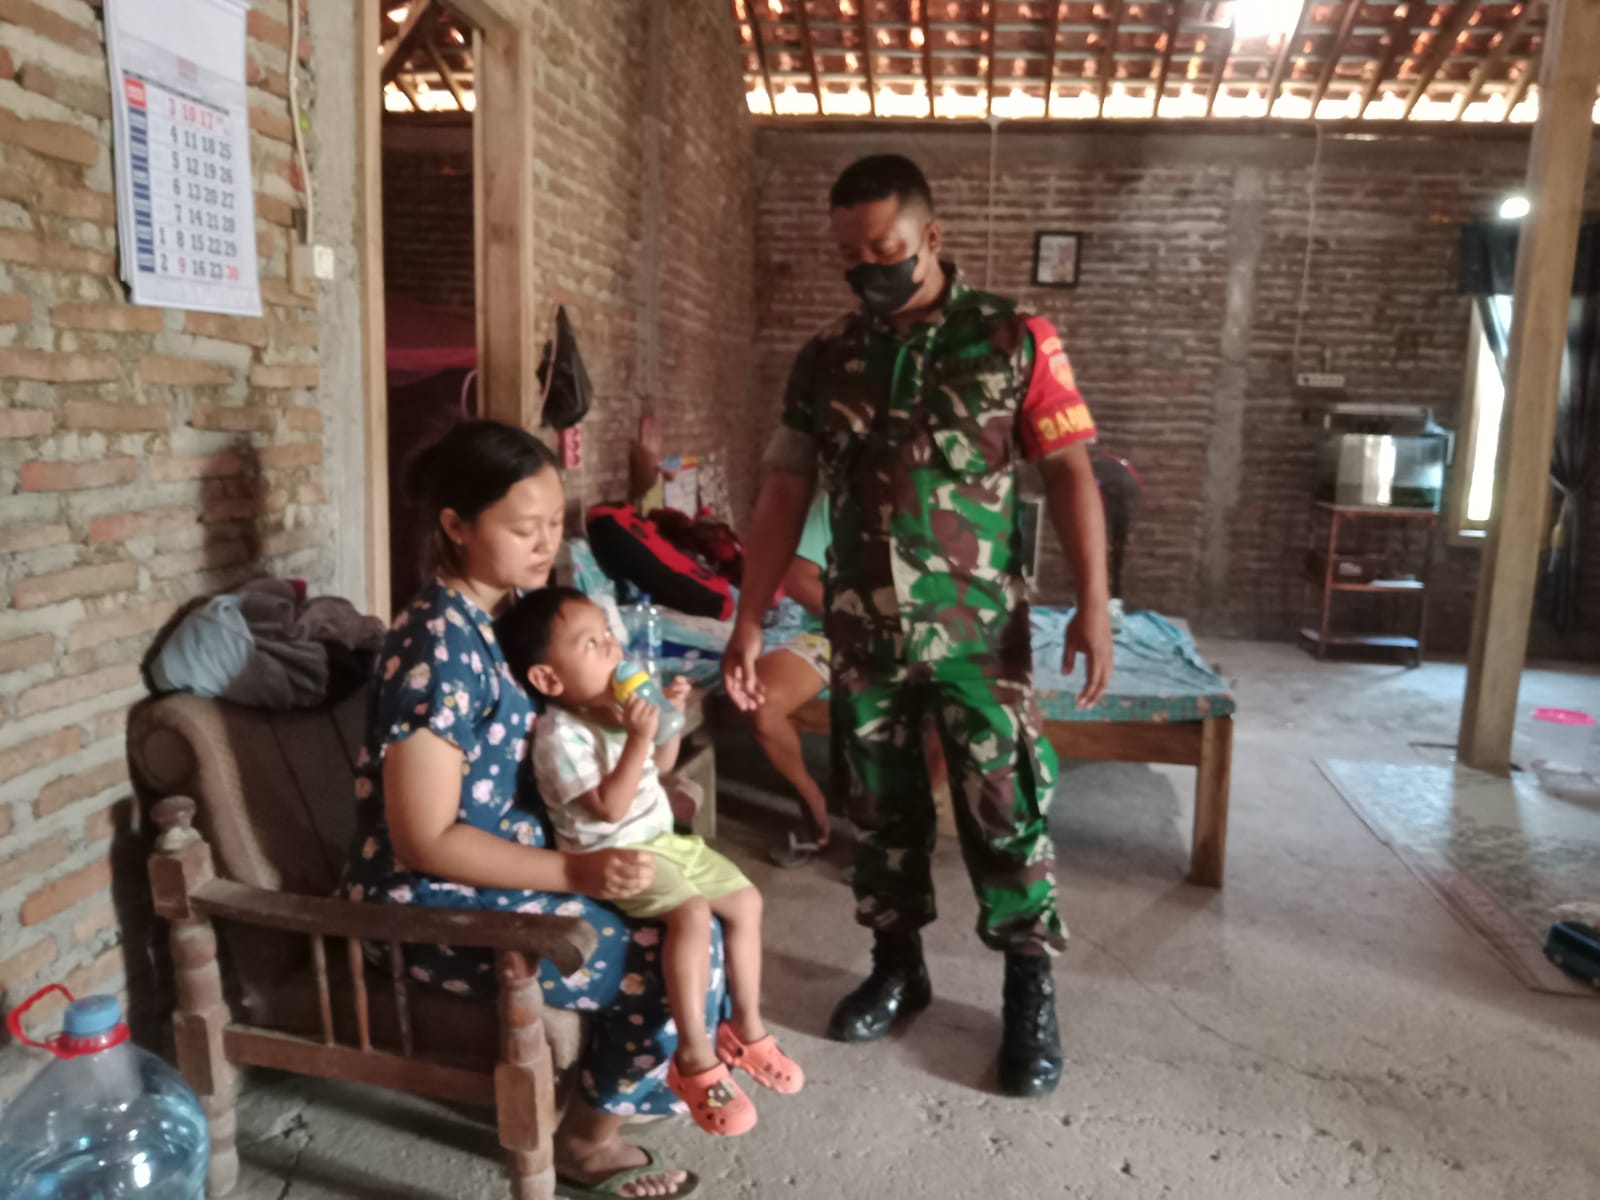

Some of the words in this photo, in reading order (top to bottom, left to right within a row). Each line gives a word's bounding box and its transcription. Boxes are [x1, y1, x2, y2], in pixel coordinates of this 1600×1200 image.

[184, 130, 198, 150] 11
[201, 135, 215, 155] 18
[219, 141, 232, 161] 25
[172, 150, 179, 170] 5
[185, 156, 199, 176] 12
[203, 161, 217, 181] 19
[220, 166, 234, 185] 26
[172, 178, 181, 196] 6
[187, 182, 201, 201] 13
[204, 186, 218, 206] 20
[221, 191, 235, 209] 27
[174, 203, 182, 222] 7
[189, 207, 203, 226] 14
[206, 211, 219, 231] 21
[222, 215, 235, 234] 28
[160, 226, 166, 246] 1
[176, 229, 184, 249] 8
[191, 233, 204, 252] 15
[207, 236, 221, 255] 22
[223, 240, 237, 258] 29
[161, 253, 168, 272] 2
[178, 256, 186, 274] 9
[192, 259, 206, 277] 16
[209, 261, 223, 280] 23
